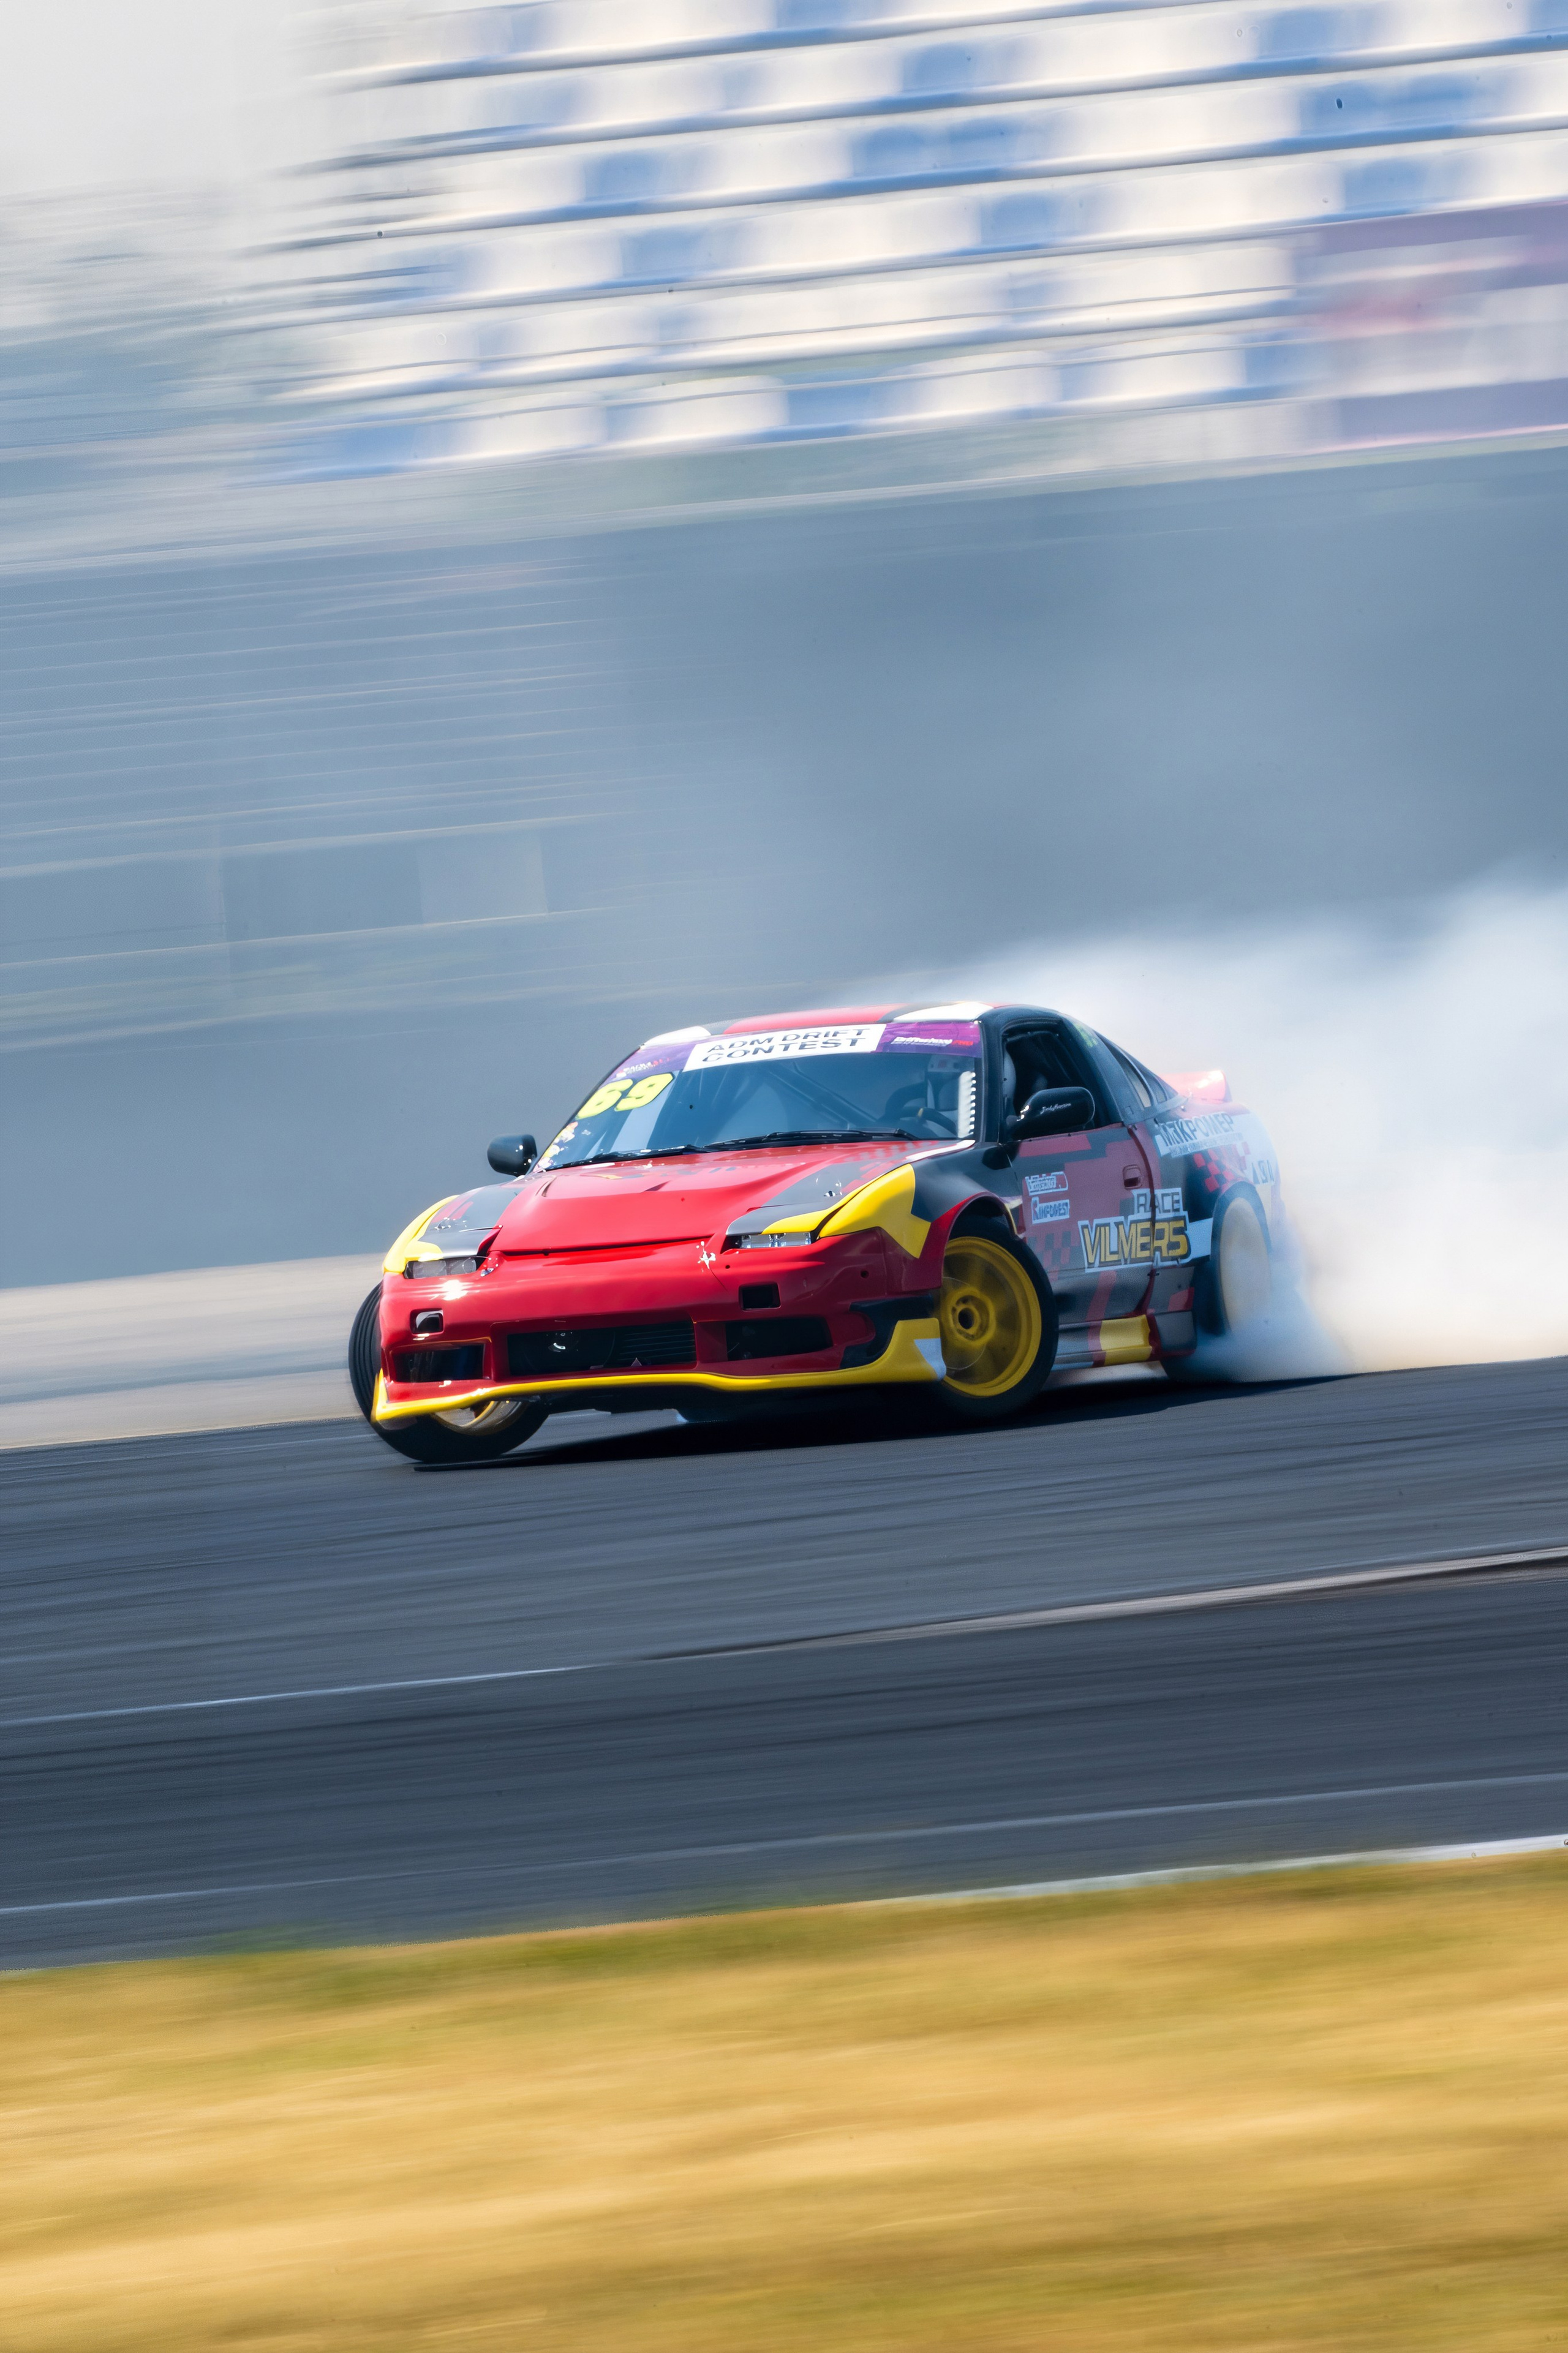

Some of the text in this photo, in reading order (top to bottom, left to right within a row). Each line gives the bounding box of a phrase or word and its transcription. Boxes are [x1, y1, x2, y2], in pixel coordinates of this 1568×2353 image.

[703, 1037, 866, 1062] CONTEST
[707, 1029, 870, 1053] ADM DRIFT
[575, 1073, 674, 1120] 69
[1136, 1191, 1181, 1214] RACE
[1082, 1218, 1189, 1266] VILMERS
